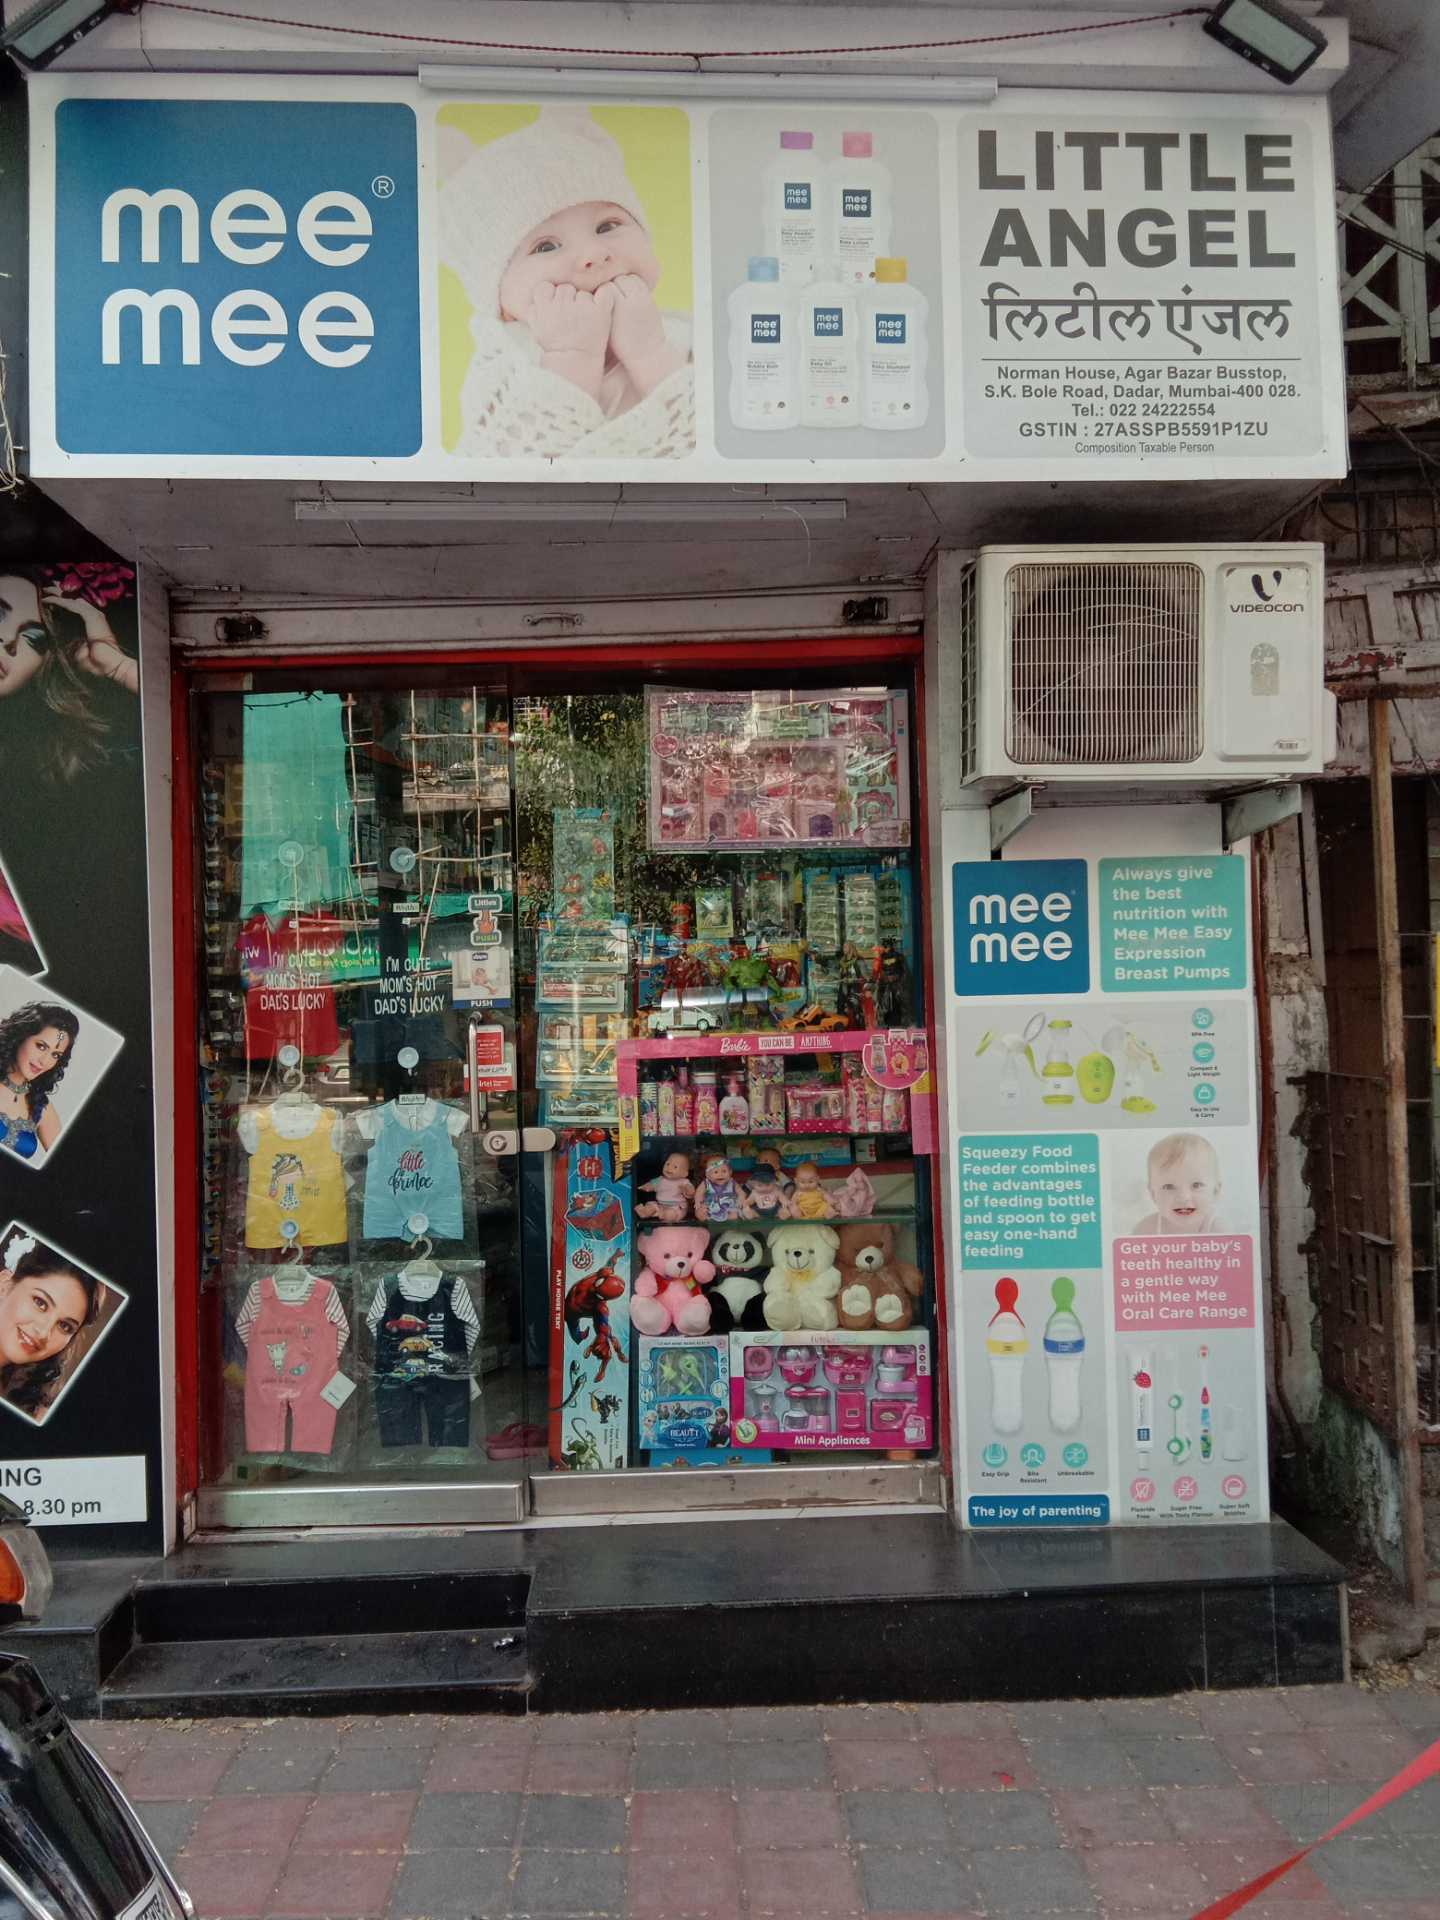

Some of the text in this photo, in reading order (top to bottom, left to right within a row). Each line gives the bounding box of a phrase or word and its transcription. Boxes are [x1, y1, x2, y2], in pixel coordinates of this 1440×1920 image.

[978, 130, 1295, 192] LITTLE
[101, 188, 372, 266] mee
[979, 208, 1296, 268] ANGEL
[981, 282, 1292, 356] लिटील एंजल
[102, 288, 374, 368] mee
[997, 366, 1287, 383] Norman House, Agar Bazar Busstop,
[984, 385, 1301, 400] S.K. Bole Road, Dadar, Mumbai-400 028.
[1072, 403, 1216, 417] Tel.: 022 24222554
[1019, 422, 1077, 437] GSTIN
[1094, 421, 1268, 437] 27ASSPB5591P1ZU
[1075, 441, 1215, 454] Composition Taxable Person
[1229, 603, 1304, 613] VIDEOCON
[1113, 866, 1213, 882] Always give
[1113, 886, 1181, 900] the best
[969, 893, 1072, 925] mee
[1113, 905, 1228, 920] nutrition with
[1114, 926, 1232, 941] Mee Mee Easy
[970, 931, 1073, 963] mee
[1114, 947, 1206, 962] Expression
[404, 957, 431, 972] CUTE
[1115, 965, 1231, 980] Breast Pumps
[417, 976, 438, 992] HOT
[291, 992, 326, 1010] LUCKY
[409, 995, 445, 1013] LUCKY
[471, 999, 493, 1007] PUSH
[720, 1038, 751, 1054] Barbie
[962, 1145, 1072, 1161] Squeezy Food
[963, 1161, 1096, 1175] Feeder combines
[963, 1178, 1083, 1193] the advantages
[963, 1194, 1095, 1210] of feeding bottle
[964, 1212, 1096, 1227] and spoon to get
[964, 1228, 1078, 1243] easy one-hand
[965, 1244, 1024, 1260] feeding
[1120, 1239, 1241, 1256] Get your baby's
[1120, 1256, 1241, 1272] teeth healthy in
[1121, 1274, 1219, 1290] a gentle way
[1121, 1290, 1227, 1304] with Mee Mee
[1122, 1306, 1248, 1321] Oral Care Range
[428, 1312, 445, 1376] RACING
[794, 1434, 871, 1447] Mini Appliances
[23, 1499, 102, 1518] 8.30 pm
[972, 1505, 1101, 1518] The joy of parenting
